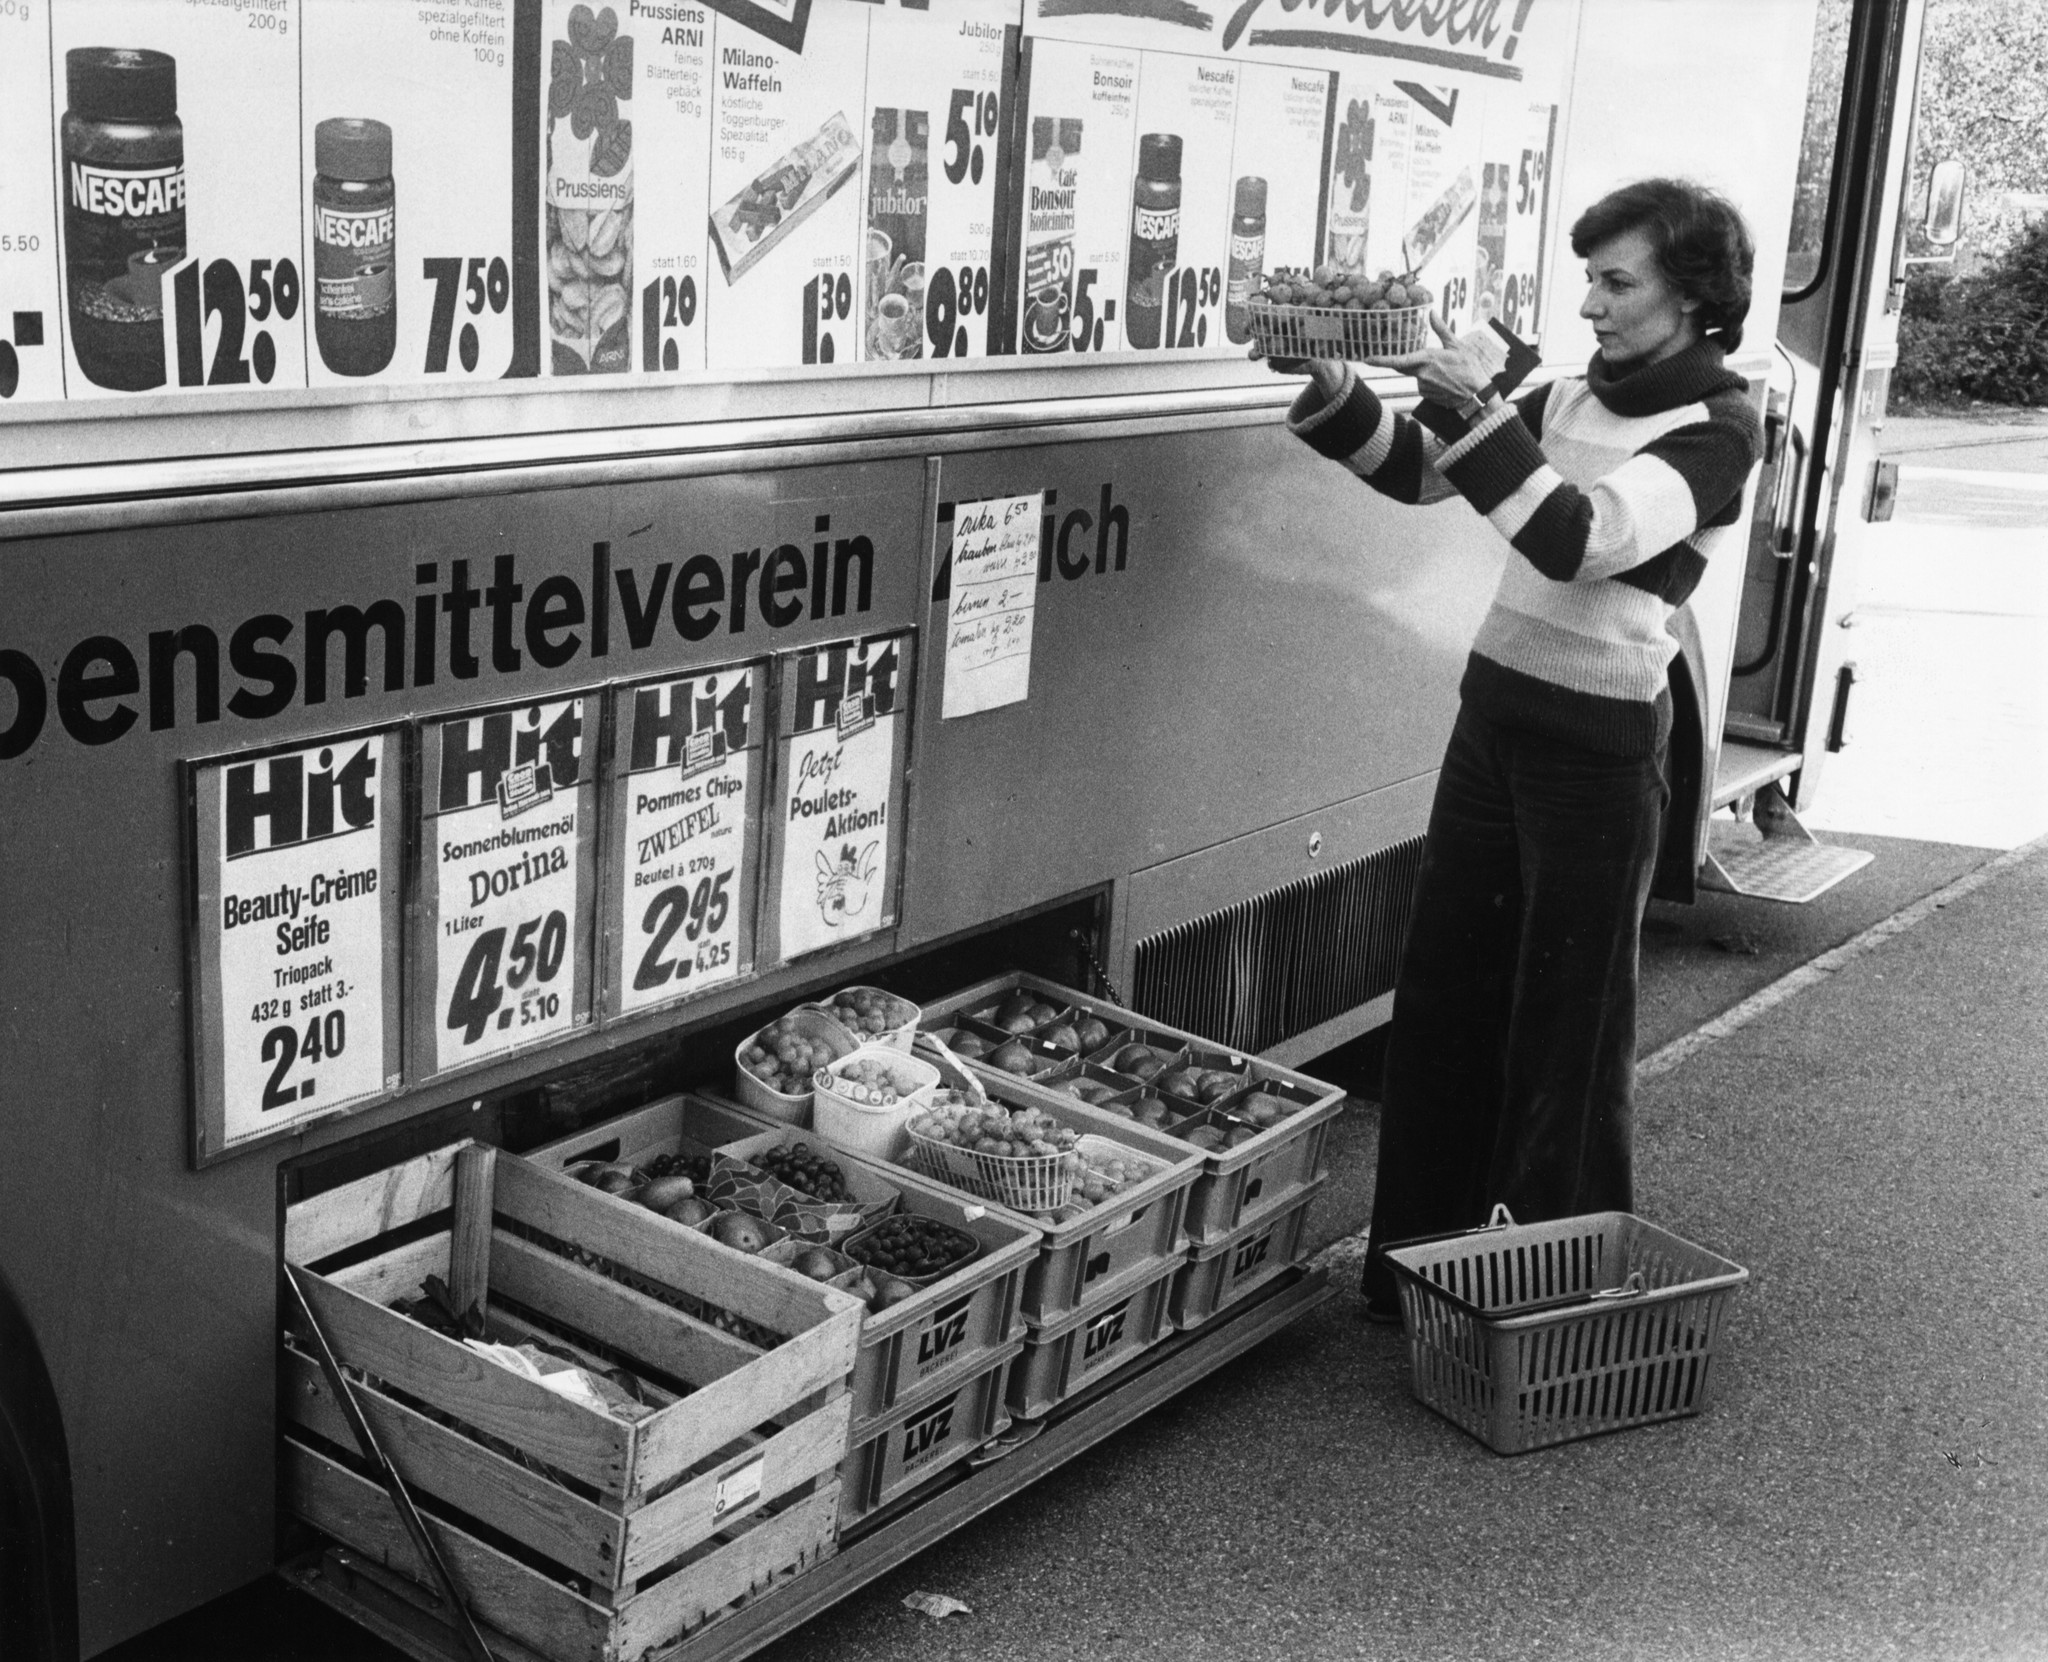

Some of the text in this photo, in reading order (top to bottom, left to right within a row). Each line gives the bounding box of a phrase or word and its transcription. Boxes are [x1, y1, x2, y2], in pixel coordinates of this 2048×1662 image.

[418, 9, 505, 28] spezialgefiltert
[629, 0, 706, 24] Prussiens
[429, 27, 505, 46] ohne Koffein
[661, 26, 704, 48] ARNI
[959, 20, 1003, 41] Jubilor
[646, 64, 703, 85] Blätterteig-
[674, 50, 704, 66] feines
[722, 47, 781, 70] Milano-
[1197, 65, 1236, 85] Nescafé
[666, 85, 703, 100] gebäck
[723, 71, 782, 93] Waffeln
[1093, 70, 1133, 89] Bonsoir
[1291, 76, 1326, 94] Nescafé
[721, 95, 764, 111] köstliche
[555, 177, 627, 200] Prussiens
[868, 188, 928, 220] jubilor
[1030, 186, 1077, 211] Bonsoir
[314, 203, 394, 248] NESCAFÉ
[652, 255, 676, 269] statt
[931, 483, 1130, 603] ich
[793, 638, 900, 734] Hit
[629, 671, 752, 771] Hit
[438, 703, 582, 812] Hit
[797, 745, 844, 794] Jetzt
[226, 740, 378, 858] Hit
[636, 775, 743, 815] Pommes Chips
[790, 787, 857, 822] Poulets-
[443, 814, 574, 863] Sonnenblumenöl
[637, 801, 721, 866] ZWEIFEL
[824, 802, 886, 841] Aktion!
[468, 844, 569, 908] Dorina
[634, 868, 675, 888] Beutel
[223, 867, 378, 929] Beauty-Crème
[276, 914, 331, 956] Seife
[453, 913, 485, 935] Liter
[632, 866, 735, 992] 2.95
[273, 955, 334, 989] Triopack
[695, 940, 731, 973] 4.25
[446, 908, 569, 1047] 4.50
[251, 1002, 280, 1023] 432
[300, 987, 333, 1011] statt
[521, 992, 560, 1027] 5.10
[260, 1007, 347, 1113] 2.40
[1232, 1234, 1271, 1278] LVZ
[917, 1310, 969, 1365] LVZ
[1083, 1311, 1127, 1361] LVZ
[902, 1405, 954, 1463] LVZ
